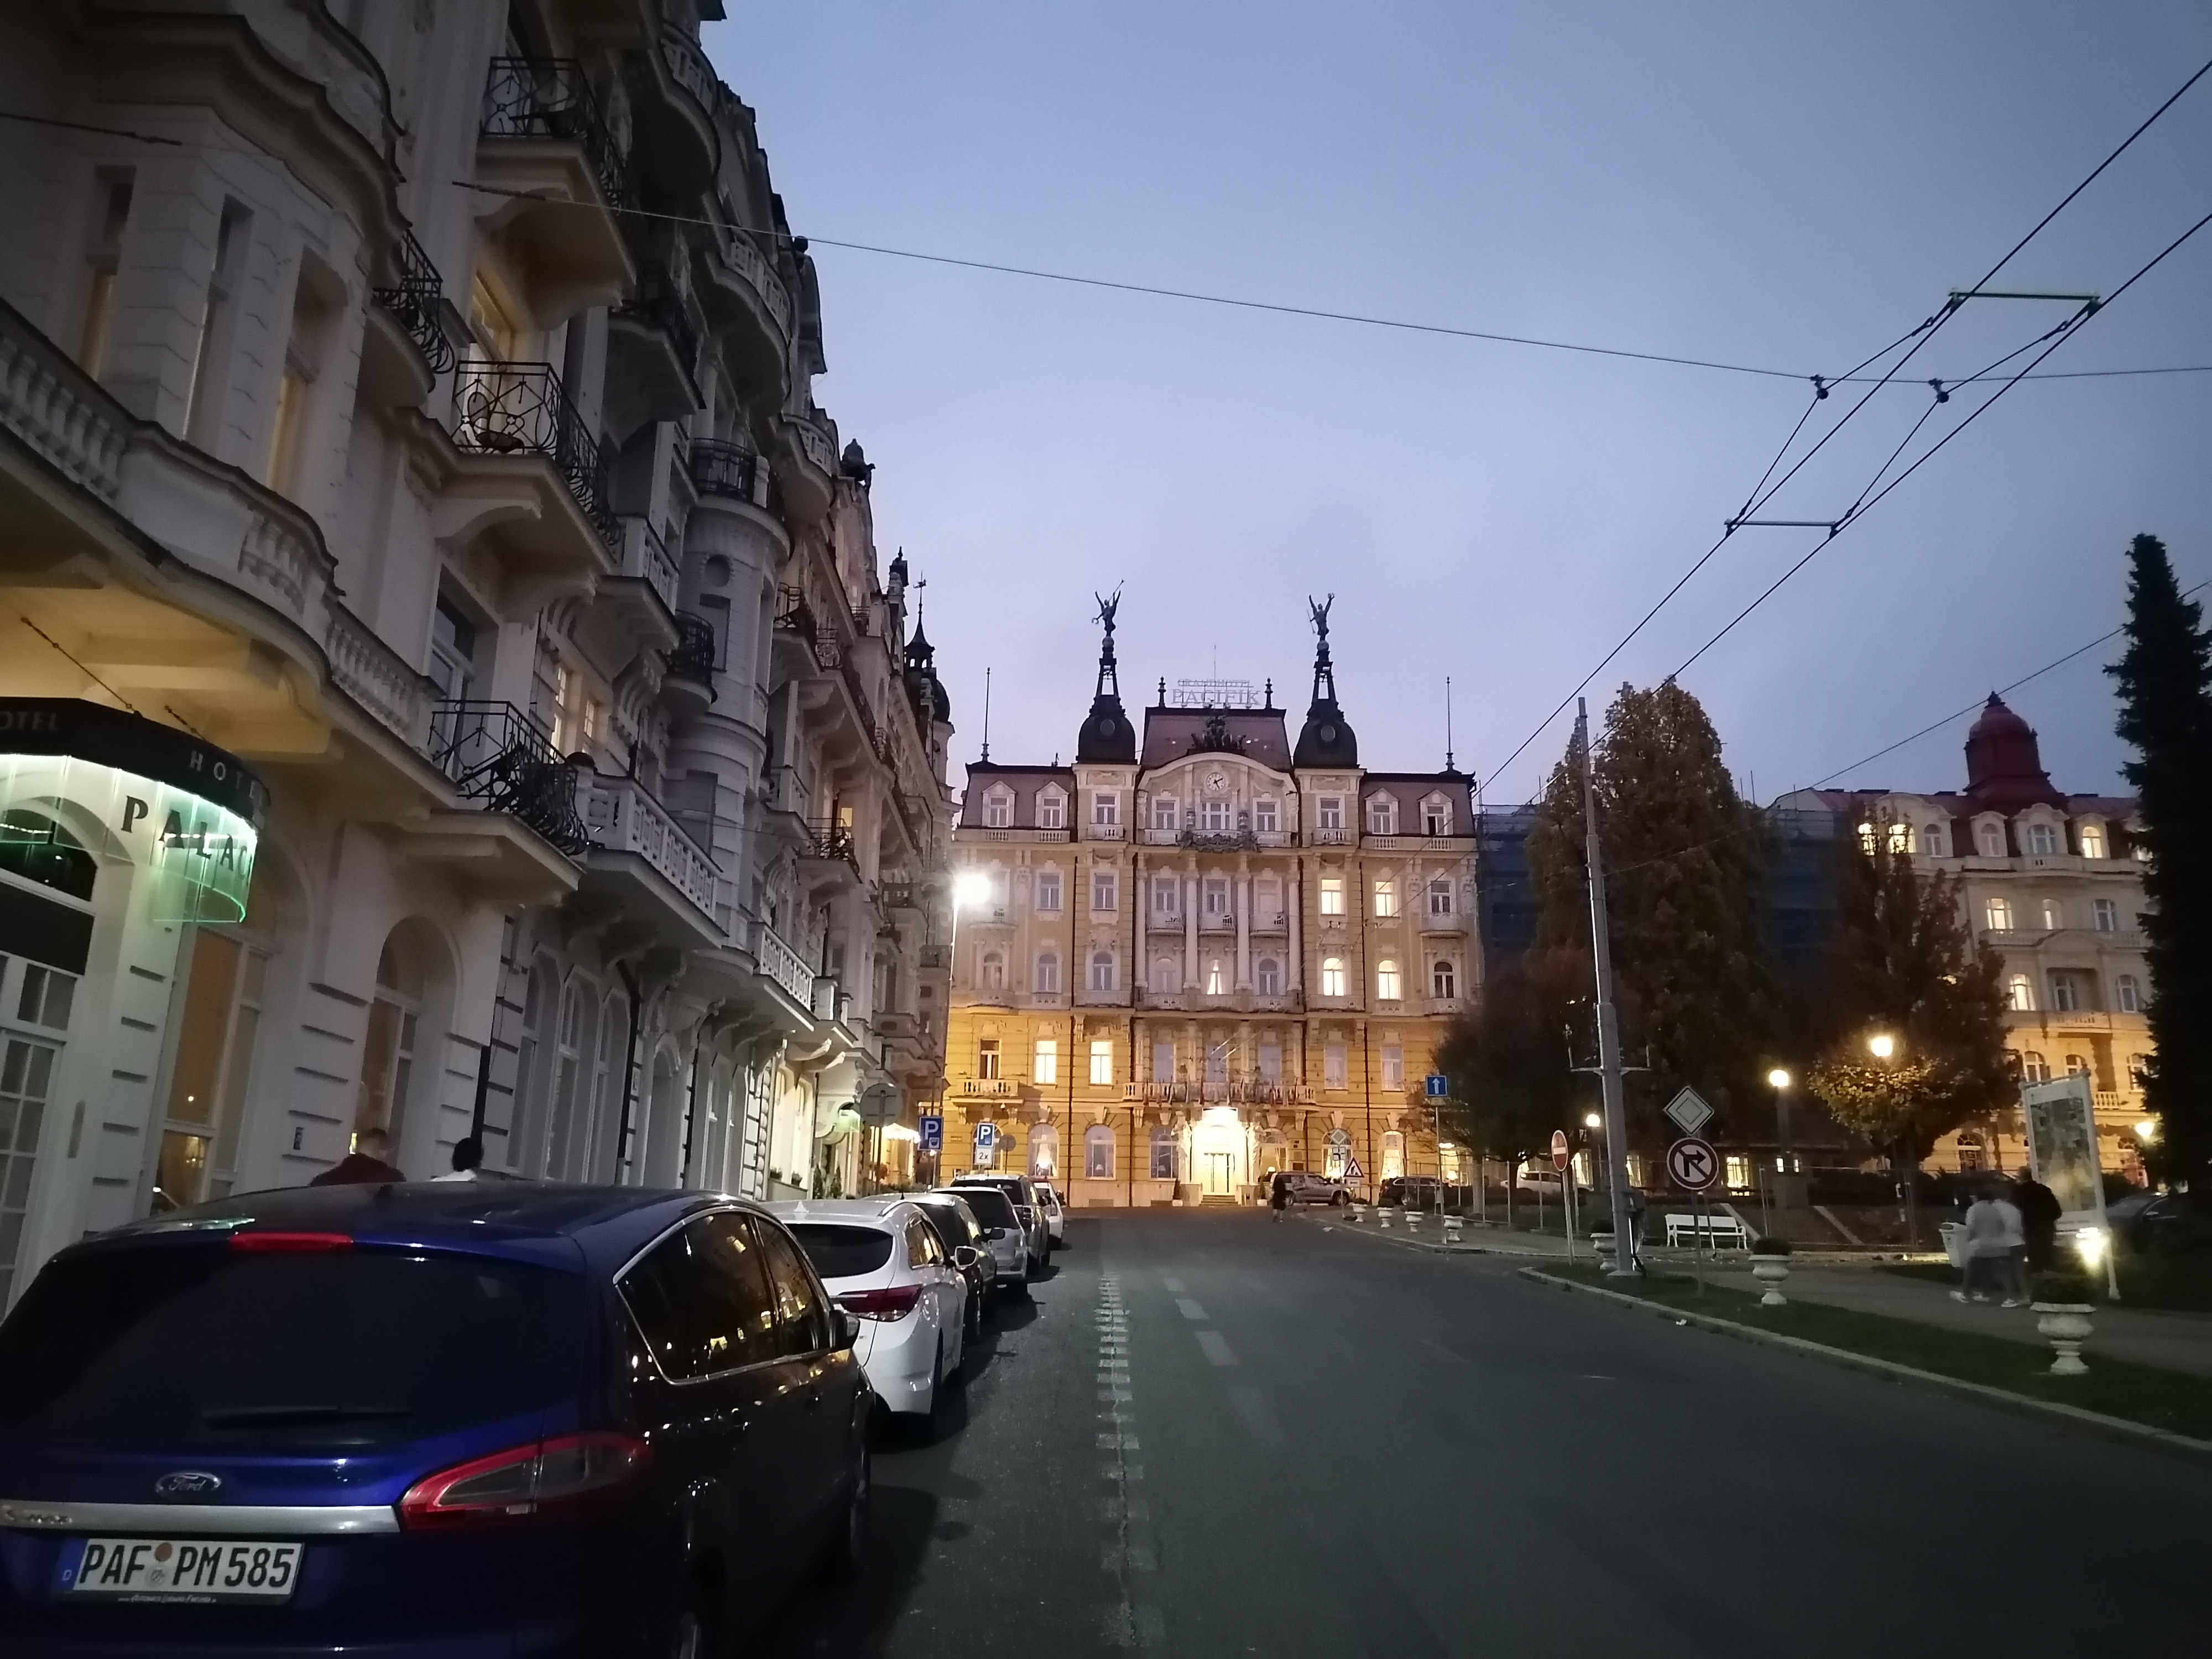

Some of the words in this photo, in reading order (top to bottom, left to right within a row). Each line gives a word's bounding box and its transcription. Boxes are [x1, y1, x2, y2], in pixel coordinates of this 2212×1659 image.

[1171, 688, 1261, 705] PACIFIK
[121, 795, 253, 886] PALAC
[924, 1121, 939, 1140] P
[980, 1126, 991, 1140] P
[979, 1152, 989, 1160] 2x
[168, 1475, 207, 1491] Ford
[79, 1544, 152, 1584] PAF
[172, 1546, 223, 1586] PM
[225, 1547, 294, 1588] 585
